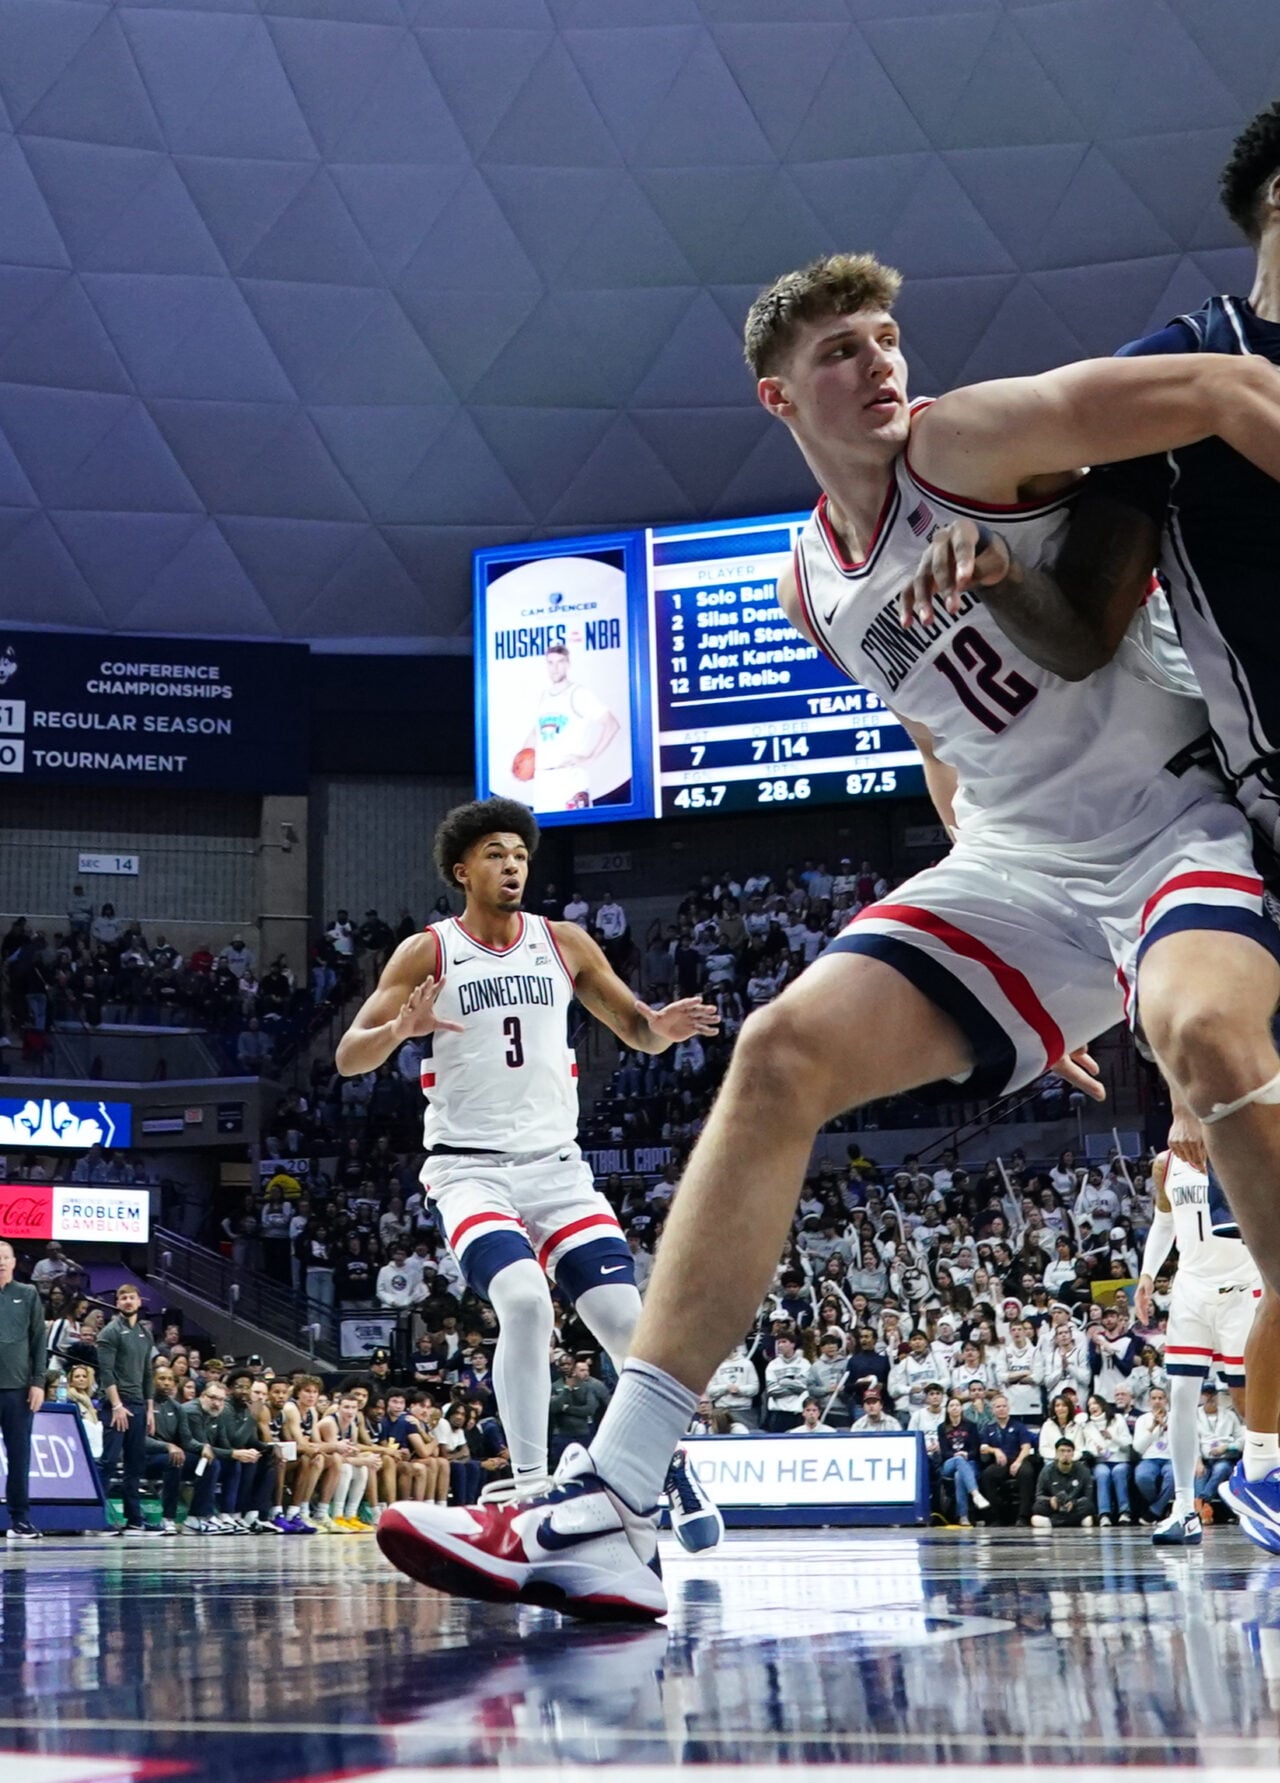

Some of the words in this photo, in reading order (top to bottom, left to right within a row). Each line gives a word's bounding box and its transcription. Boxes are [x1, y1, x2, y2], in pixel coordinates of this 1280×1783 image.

[698, 565, 756, 580] PLAYER
[672, 594, 681, 609] 1
[696, 589, 736, 607] Solo
[740, 584, 775, 602] Ball
[521, 608, 544, 616] CAM
[548, 602, 597, 613] SPENCER
[671, 615, 684, 631] 2
[697, 611, 738, 628] Silas
[495, 624, 566, 660] HUSKIES
[585, 618, 620, 651] NBA
[672, 635, 684, 652] 3
[698, 630, 750, 650] Jaylin
[100, 662, 219, 679] CONFERENCE
[671, 657, 687, 673] 11
[699, 653, 739, 670] Alex
[743, 646, 818, 666] Karaban
[87, 680, 233, 698] CHAMPIONSHIPS
[670, 678, 689, 694] 12
[700, 674, 734, 691] Eric
[739, 669, 790, 688] Reibe
[933, 626, 1038, 734] 12
[807, 695, 861, 714] TEAM
[33, 711, 136, 731] REGULAR
[143, 716, 232, 734] SEASON
[853, 715, 880, 727] REB
[690, 746, 706, 766] 7
[752, 740, 767, 760] 7
[855, 730, 881, 751] 21
[33, 751, 187, 771] TOURNAMENT
[674, 785, 727, 808] 45.7
[758, 778, 811, 802] 28.6
[846, 771, 896, 794] 87.5
[80, 859, 100, 868] SEC
[115, 858, 132, 870] 14
[458, 975, 553, 1016] CONNECTICUT
[503, 1016, 524, 1068] 3
[62, 1204, 140, 1219] PROBLEM
[61, 1219, 140, 1232] GAMBLING
[1197, 1211, 1204, 1242] 1
[777, 1458, 906, 1482] HEALTH
